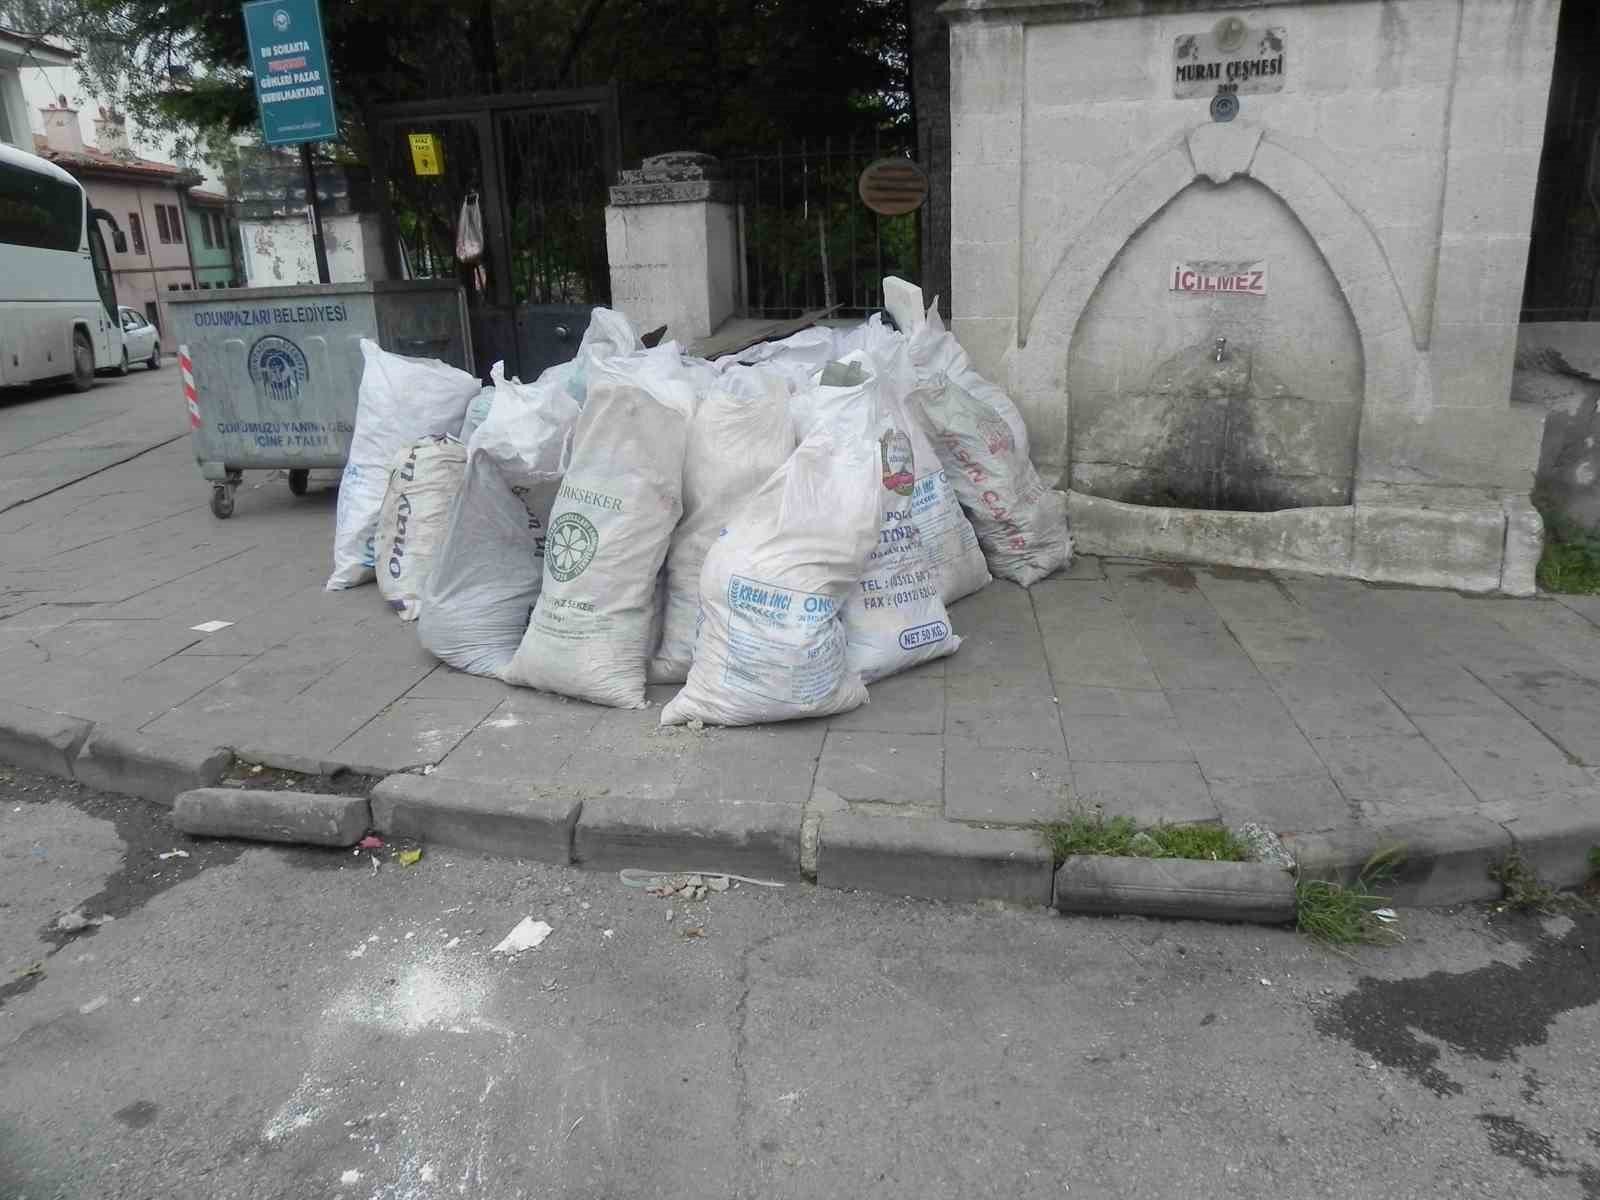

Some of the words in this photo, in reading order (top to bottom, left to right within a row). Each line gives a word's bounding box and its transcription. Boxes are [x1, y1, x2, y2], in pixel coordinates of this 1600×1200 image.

[294, 70, 321, 84] PAZAR
[1176, 62, 1222, 82] MURAT
[194, 308, 271, 328] ODUNPAZARI
[860, 577, 882, 593] TEL
[904, 631, 920, 646] NET
